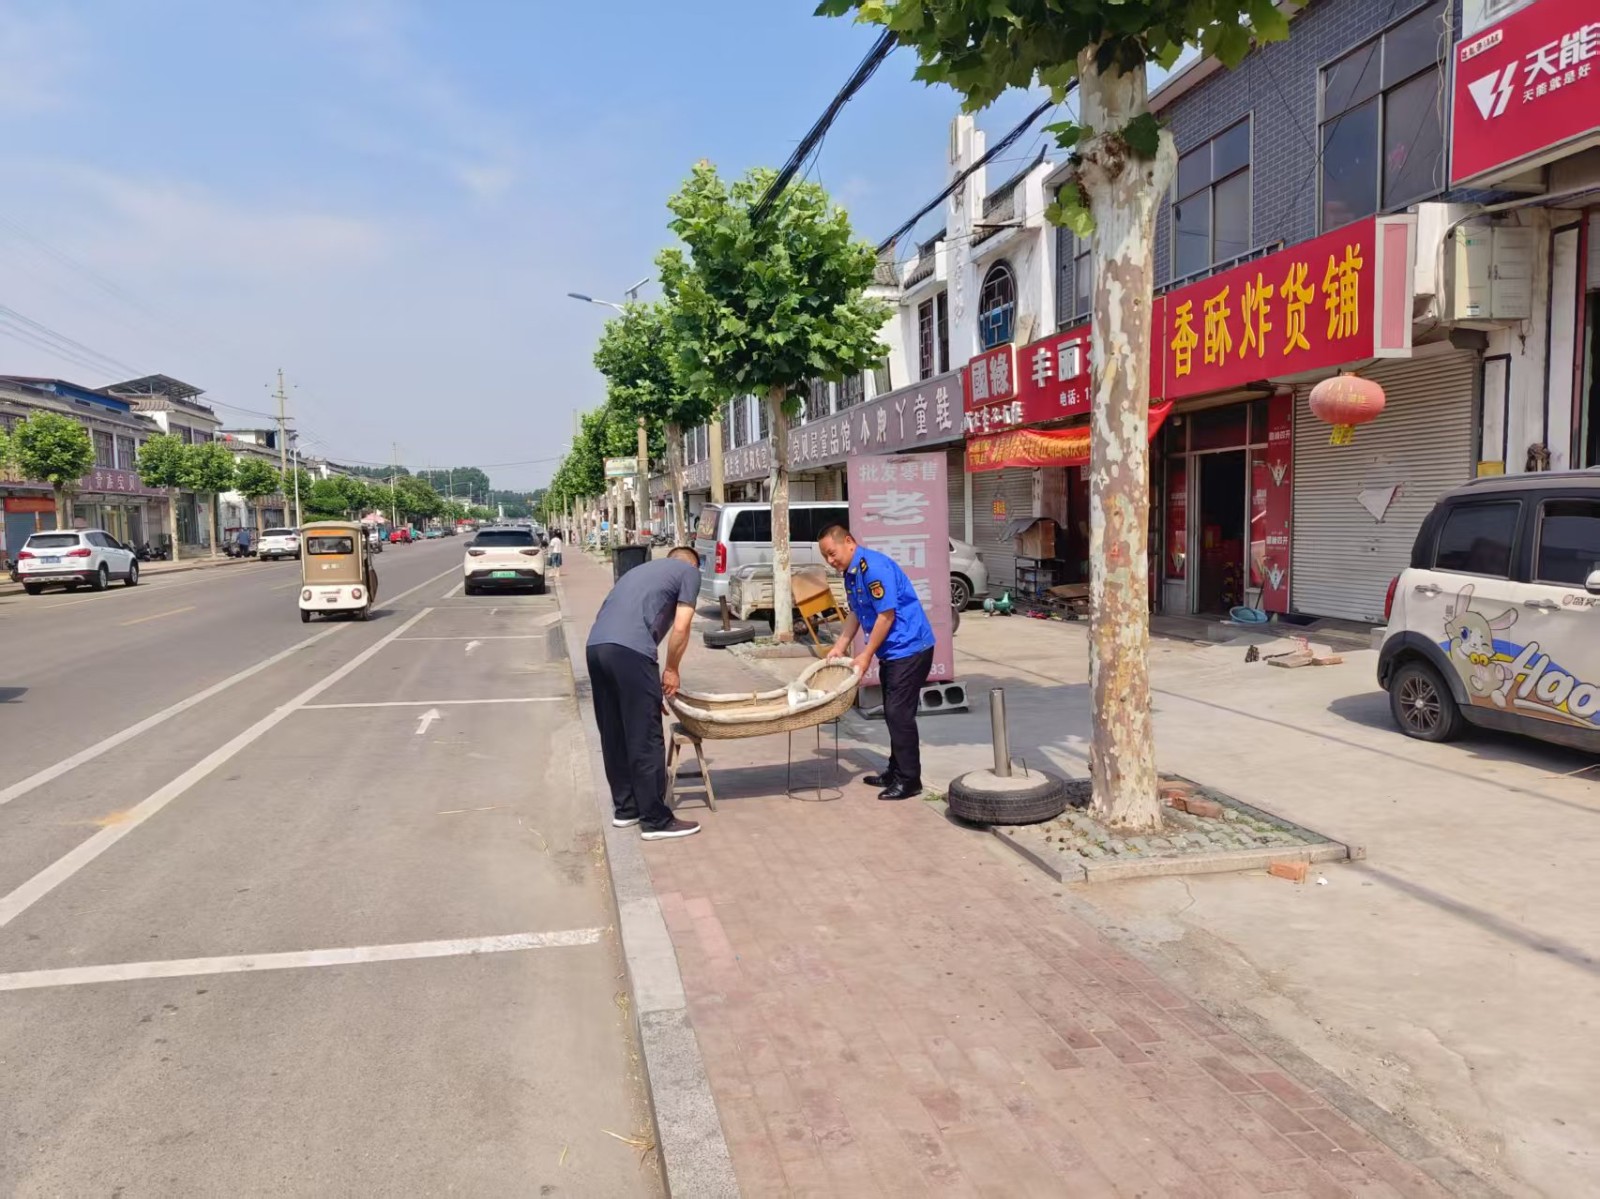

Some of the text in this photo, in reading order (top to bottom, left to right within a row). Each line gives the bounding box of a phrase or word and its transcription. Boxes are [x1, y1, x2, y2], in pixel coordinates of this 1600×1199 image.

[1524, 22, 1600, 87] 天能
[1171, 243, 1363, 379] 香酥炸货铺
[1032, 335, 1092, 389] 丰丽
[858, 461, 938, 482] 批发零售
